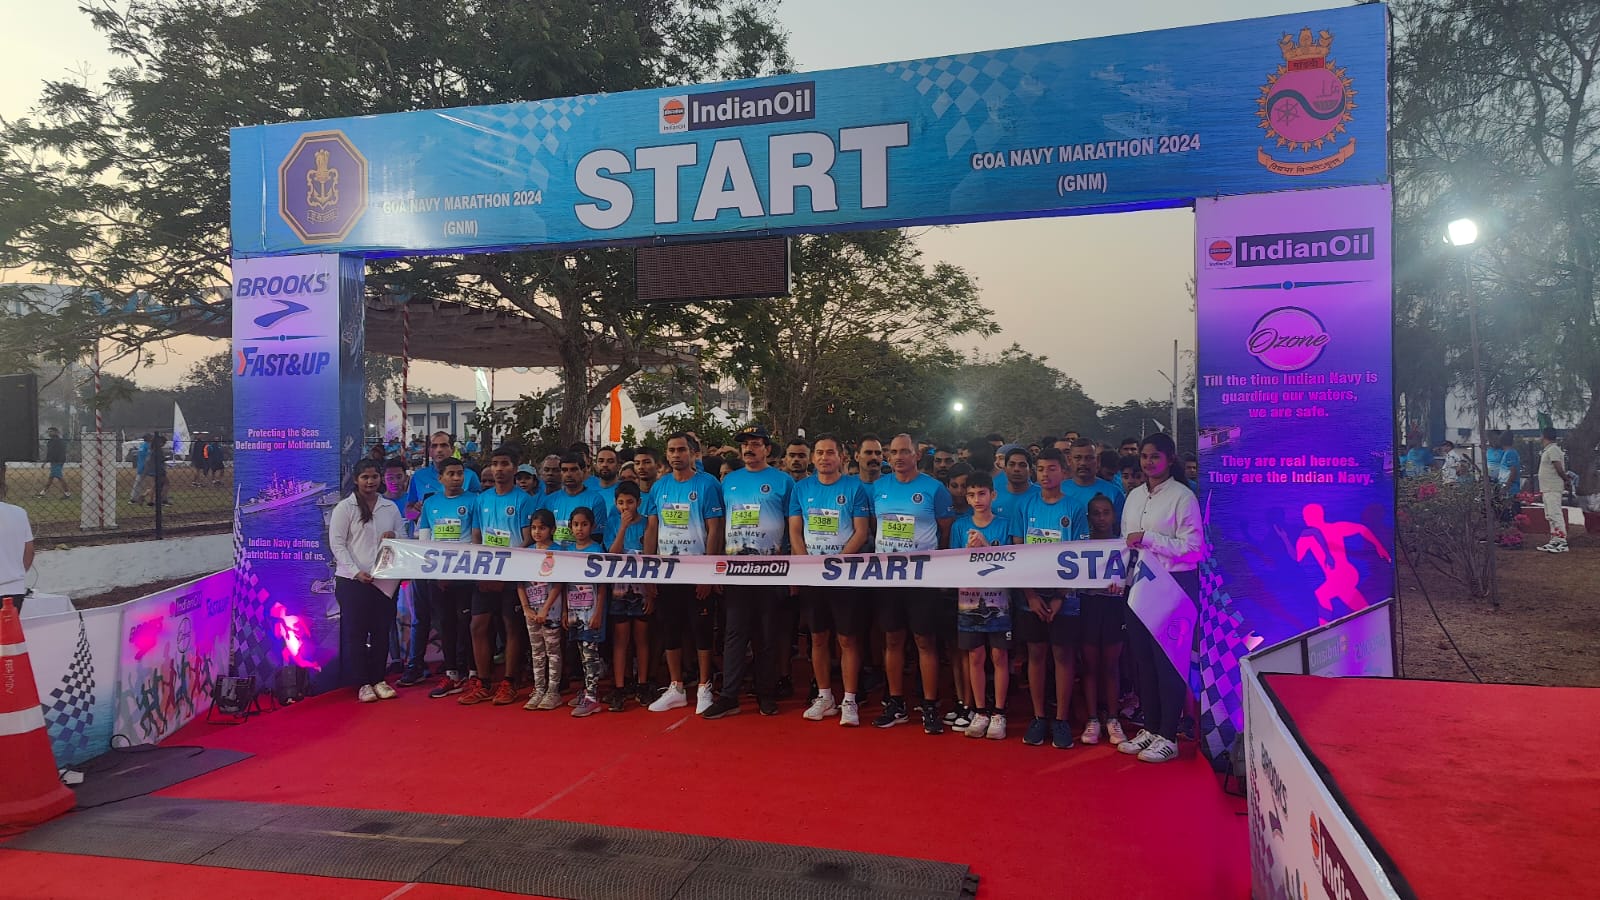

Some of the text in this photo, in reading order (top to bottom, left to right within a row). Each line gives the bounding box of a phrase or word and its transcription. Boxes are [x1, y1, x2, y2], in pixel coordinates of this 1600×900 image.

[693, 89, 811, 124] IndianOil
[971, 133, 1201, 170] GOA NAVY MARATHON 2024
[574, 122, 909, 230] START
[1057, 173, 1108, 196] (GNM)
[383, 190, 542, 214] GOA NAVY MARATHON 2024
[443, 220, 479, 238] (GNM)
[1241, 233, 1369, 262] IndianOil
[236, 273, 328, 296] BROOKS
[1249, 328, 1330, 353] Ozone
[239, 347, 330, 376] FAST&UP
[1203, 371, 1378, 386] Till the time Indian Navy is
[1222, 389, 1358, 405] guarding our waters,
[1249, 405, 1329, 418] we are safe.
[247, 428, 319, 439] Protecting the Seas
[235, 441, 272, 451] Defending
[287, 440, 333, 449] Motherland.
[1221, 455, 1360, 469] They are real heroes.
[1208, 471, 1374, 486] They are the Indian Navy.
[813, 516, 832, 525] 5388
[888, 523, 907, 531] 5437
[557, 527, 572, 535] 542
[248, 538, 319, 548] Indian Navy defines
[281, 551, 292, 559] for
[293, 551, 303, 559] all
[305, 552, 313, 560] of
[421, 549, 511, 575] START
[584, 554, 680, 579] START
[729, 562, 788, 573] IndianOil
[821, 555, 931, 581] START
[969, 551, 1016, 563] BROOKS
